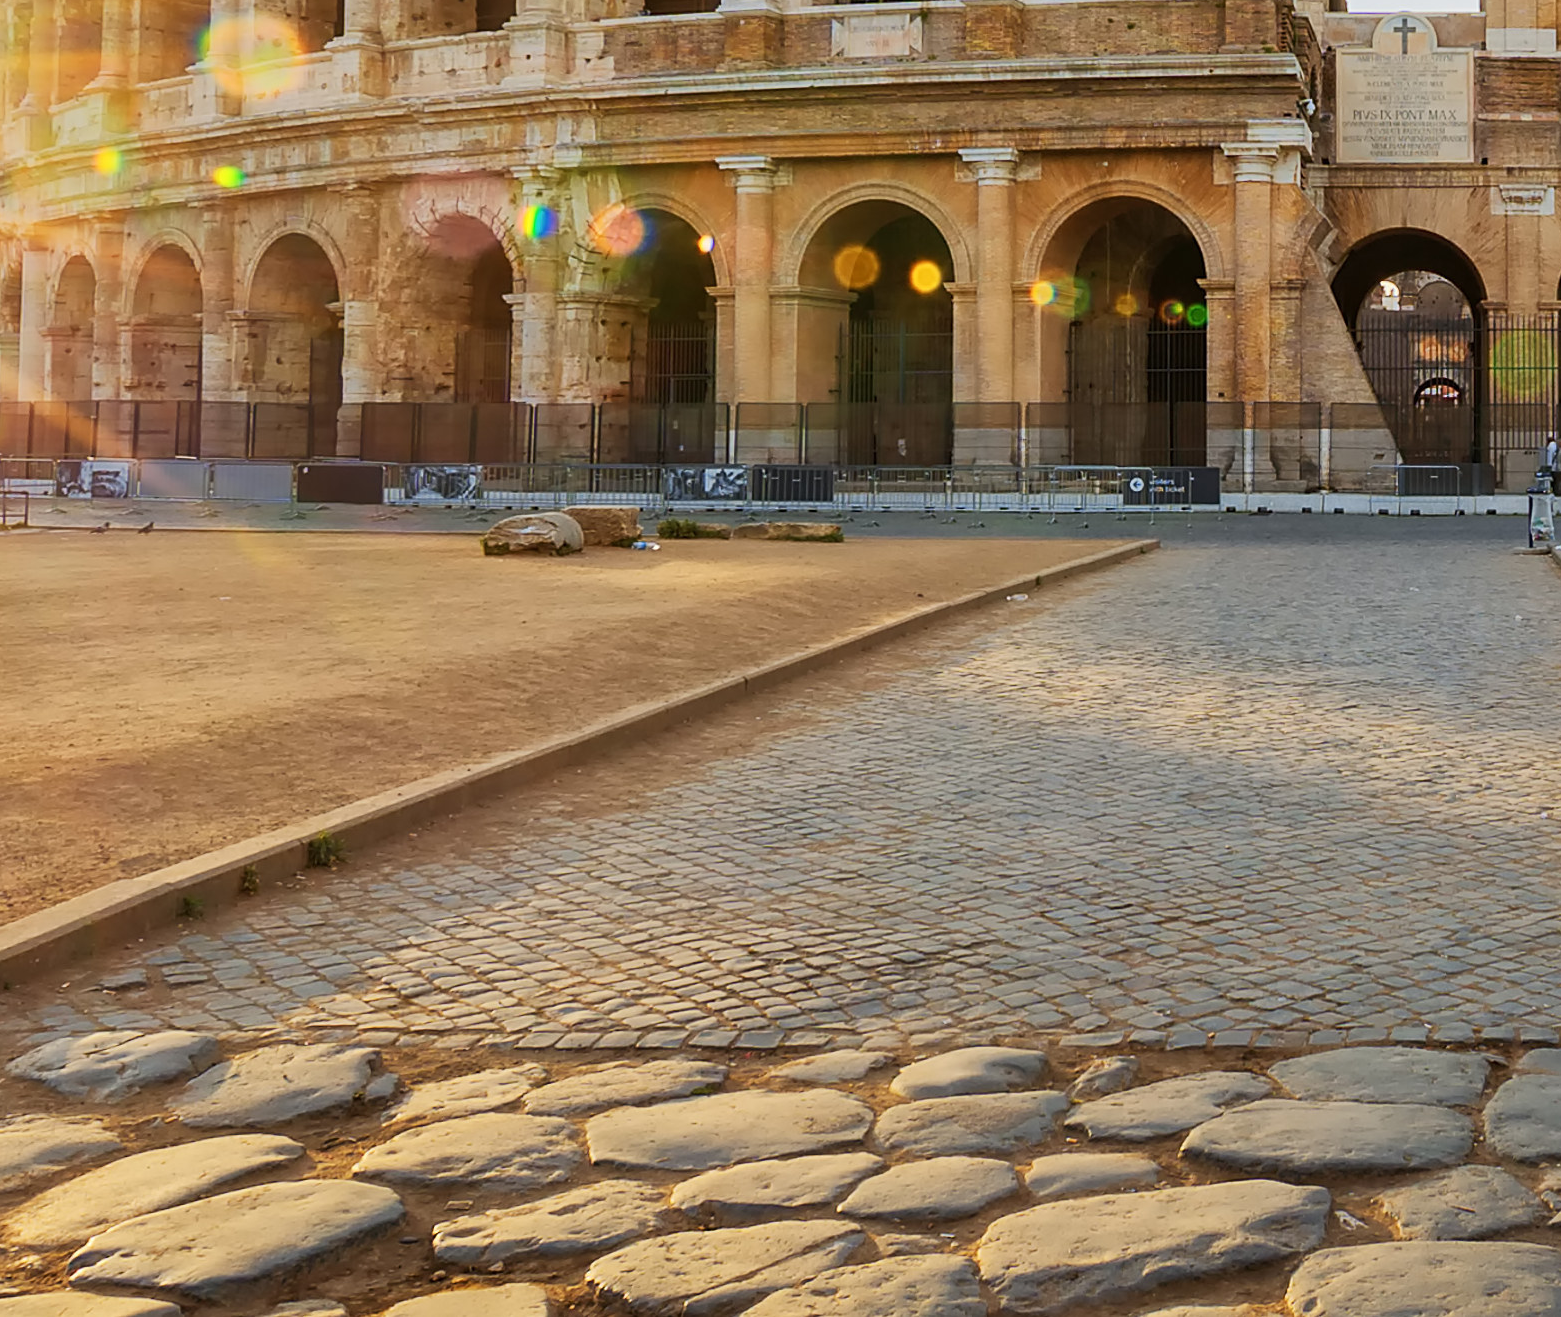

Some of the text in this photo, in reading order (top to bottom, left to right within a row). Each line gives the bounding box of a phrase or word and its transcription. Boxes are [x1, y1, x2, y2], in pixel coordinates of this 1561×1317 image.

[1380, 109, 1392, 120] IX
[1395, 109, 1425, 120] PONT
[1428, 109, 1457, 121] MAX
